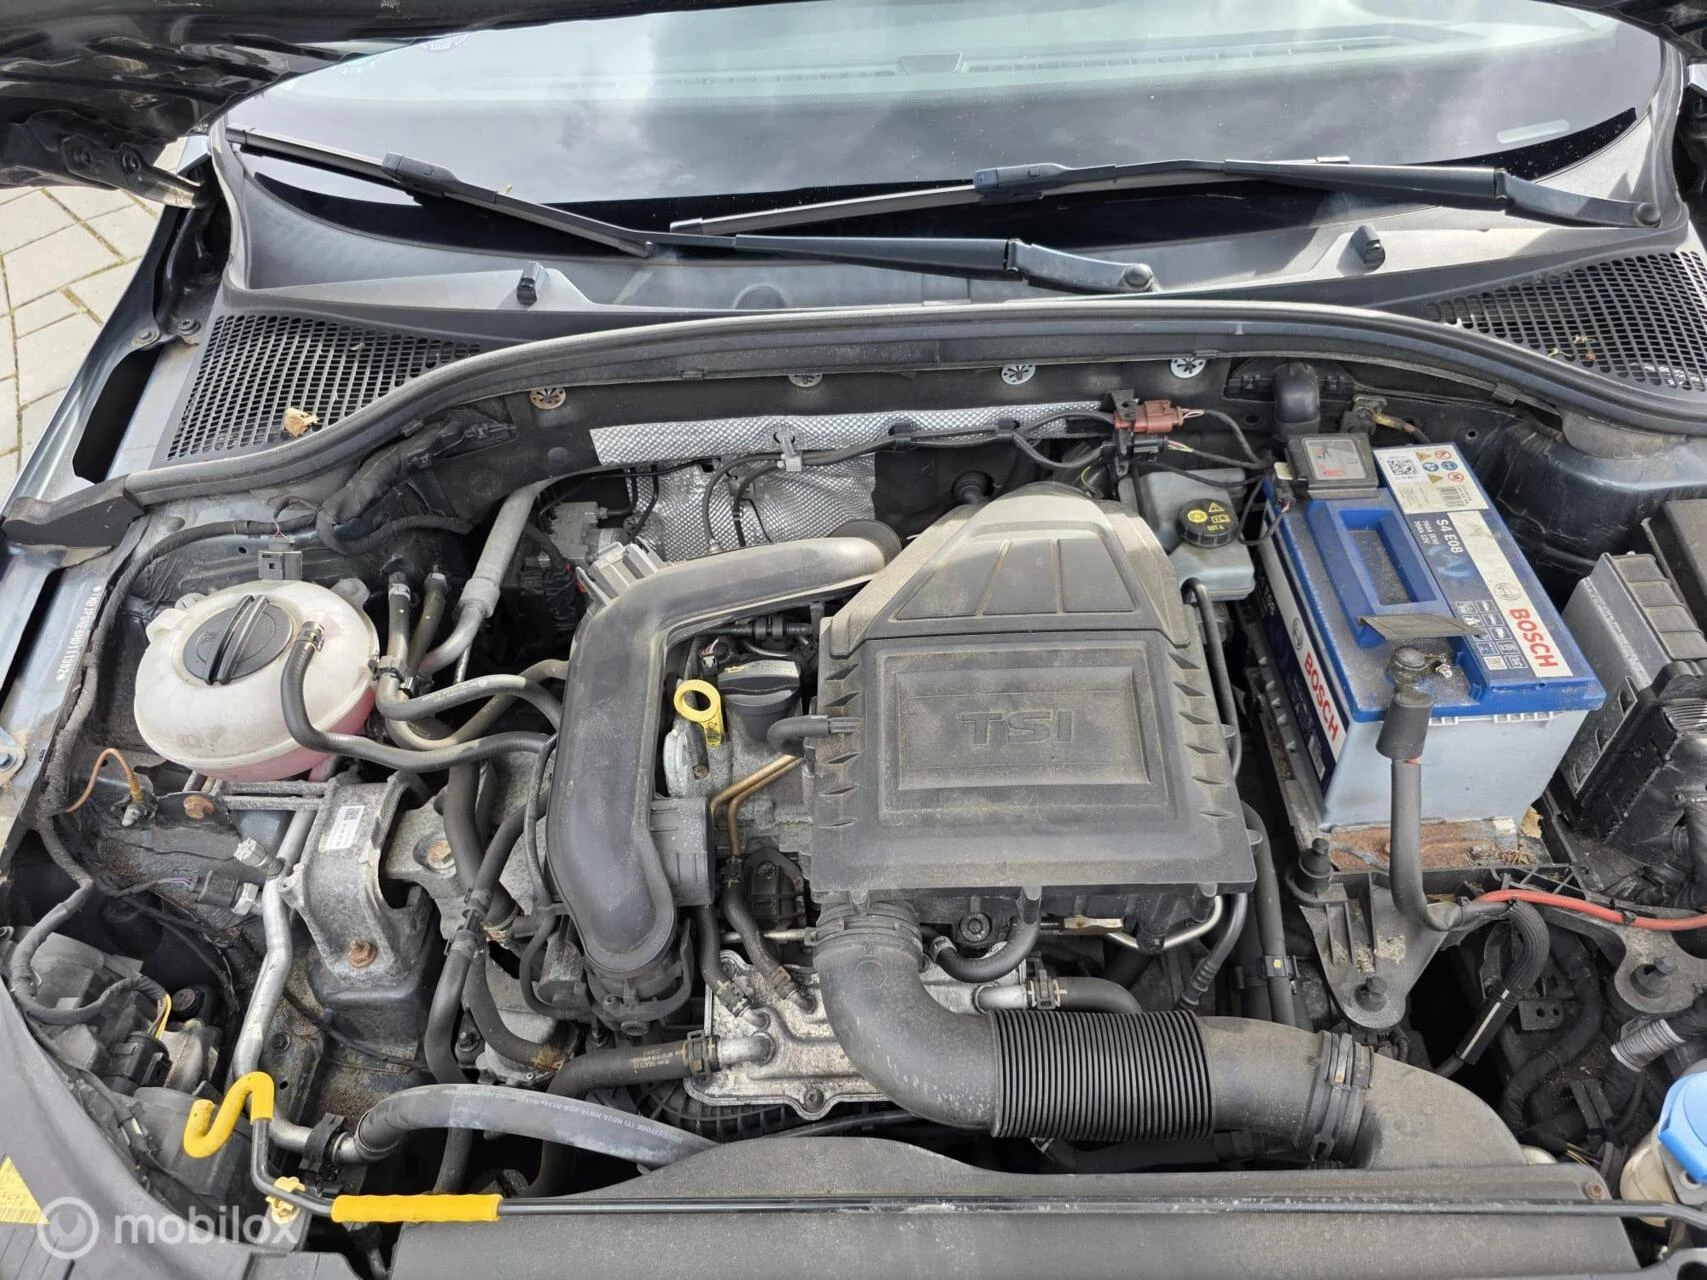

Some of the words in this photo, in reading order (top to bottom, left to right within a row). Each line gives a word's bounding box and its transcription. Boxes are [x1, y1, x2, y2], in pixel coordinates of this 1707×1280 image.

[1436, 519, 1453, 532] S4
[1444, 534, 1464, 554] E08
[1509, 608, 1559, 667] BOSCH
[1304, 651, 1339, 741] BOSCH
[960, 710, 1074, 745] TSI
